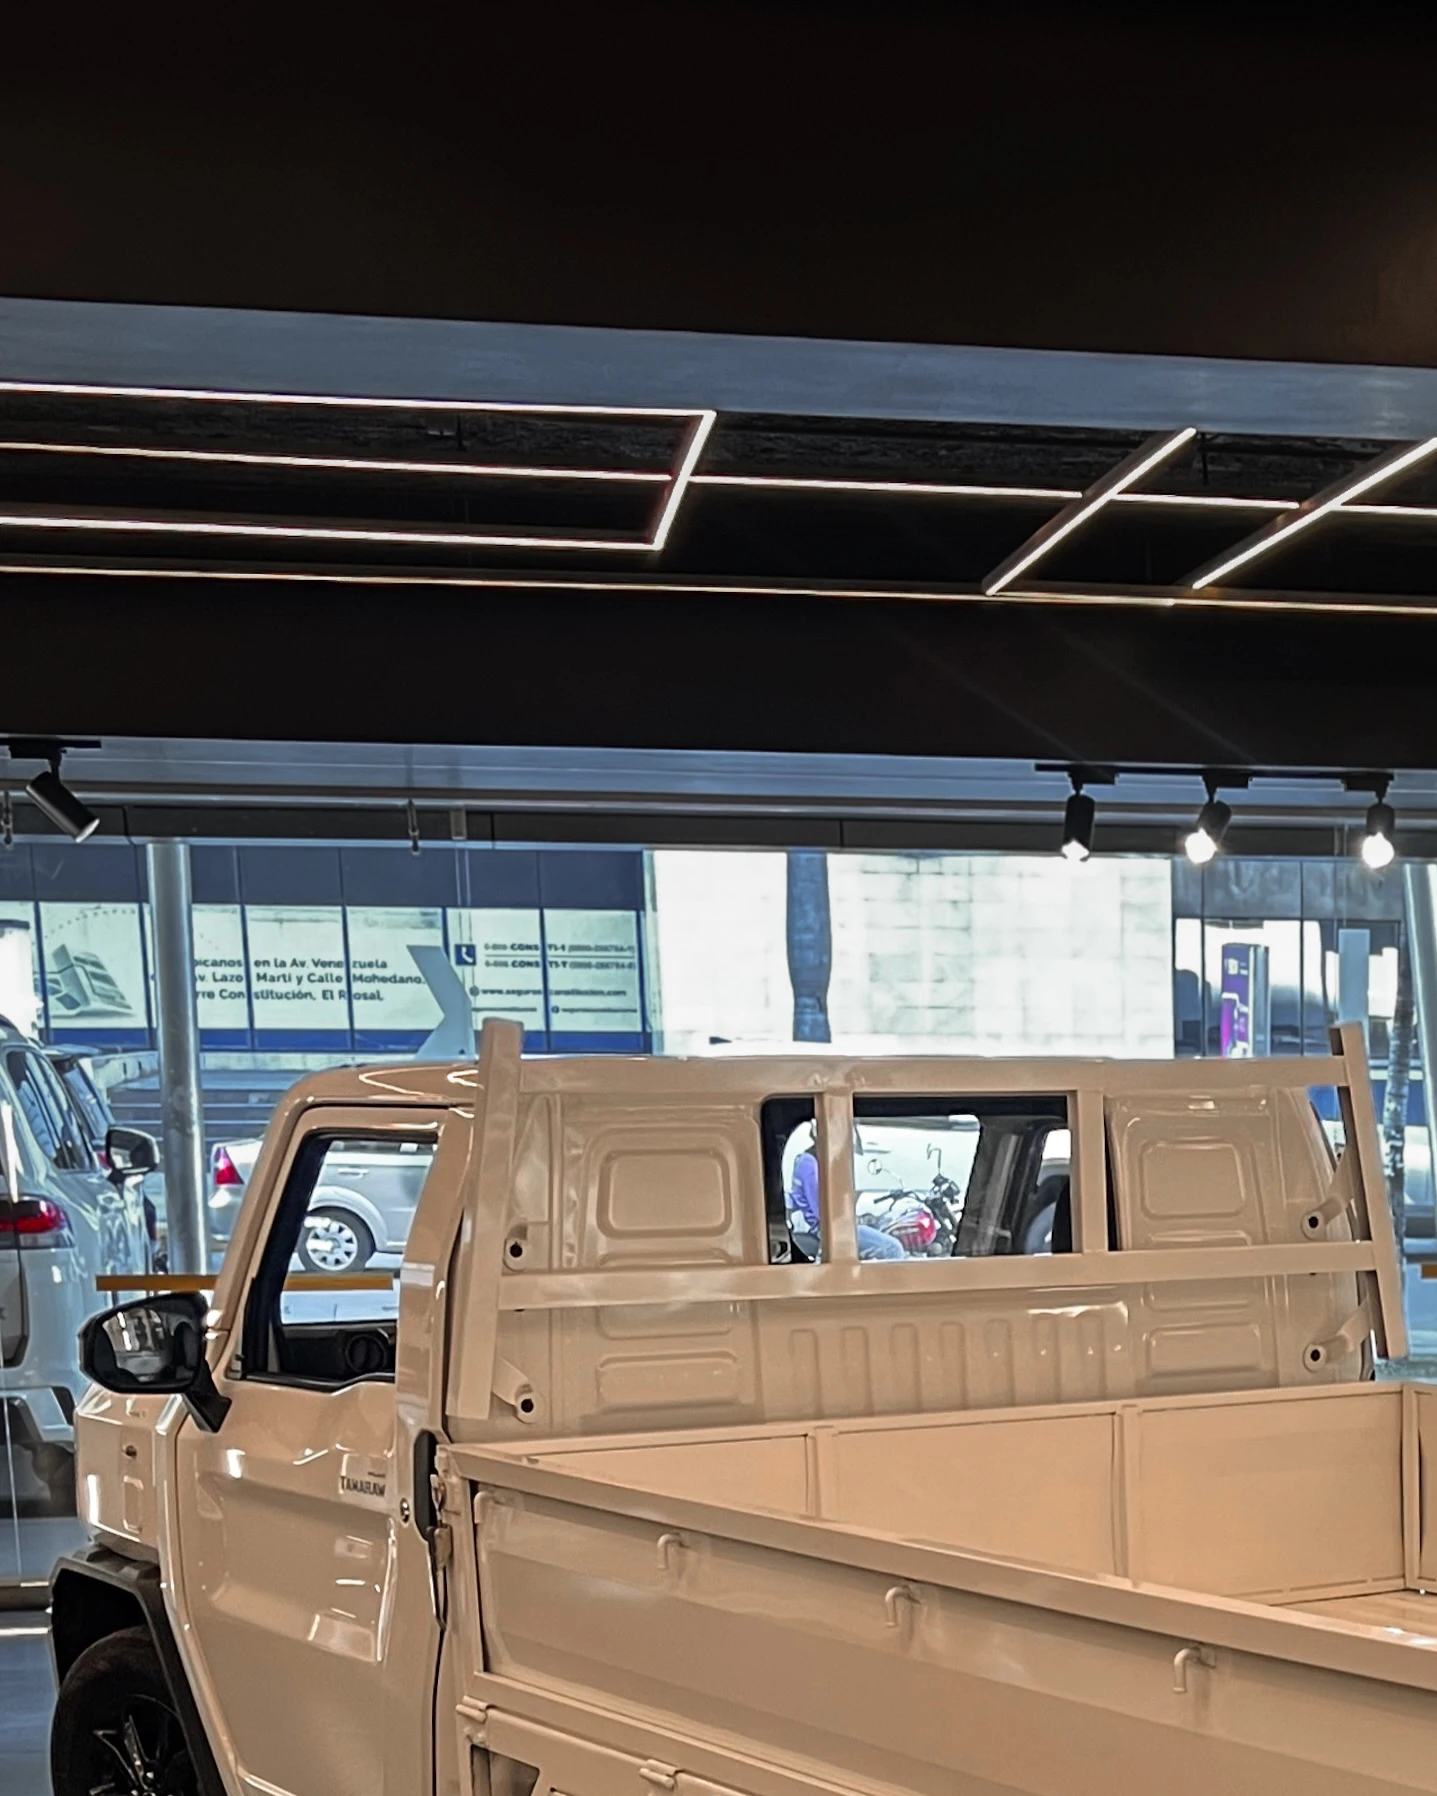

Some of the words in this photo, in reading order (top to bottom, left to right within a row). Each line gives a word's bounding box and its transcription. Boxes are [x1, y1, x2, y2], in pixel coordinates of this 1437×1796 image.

[254, 959, 271, 968] en
[274, 957, 287, 968] la
[311, 958, 388, 969] Venezuela
[212, 972, 244, 983] Lazo
[296, 975, 303, 986] y
[307, 972, 343, 984] Calle
[322, 989, 334, 1000] El
